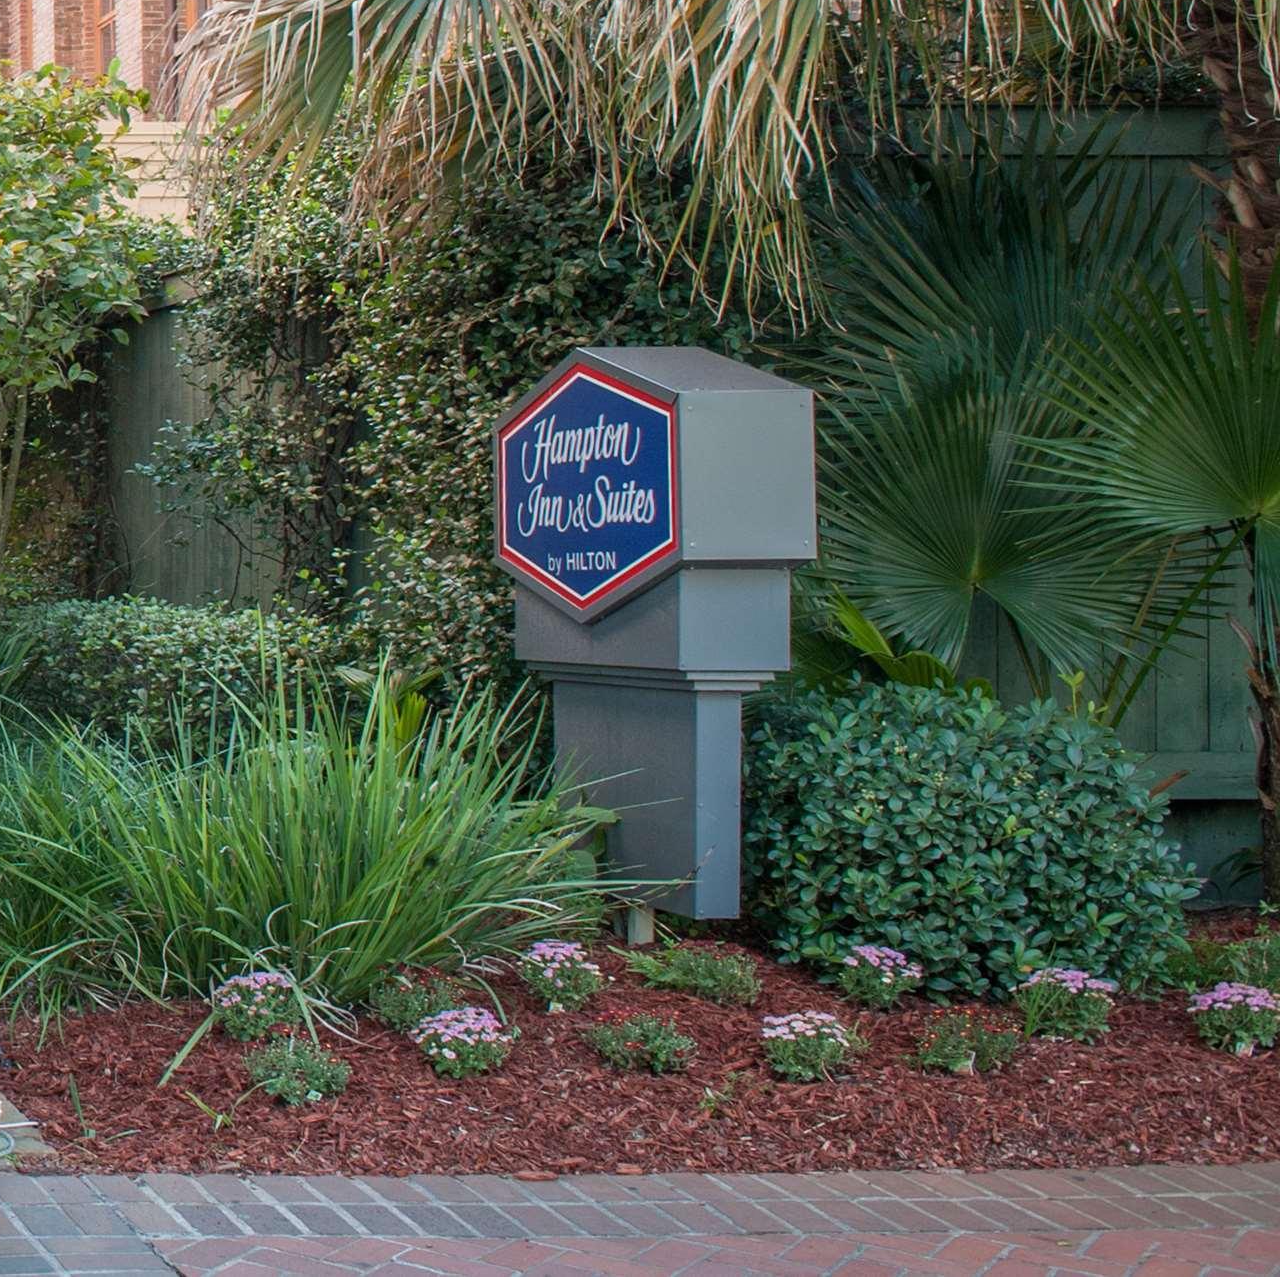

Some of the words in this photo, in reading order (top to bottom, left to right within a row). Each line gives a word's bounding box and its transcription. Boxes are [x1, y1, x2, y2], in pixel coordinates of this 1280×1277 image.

[521, 413, 641, 484] Hampton
[517, 483, 573, 537] Inn
[585, 475, 656, 529] Suites
[547, 553, 562, 576] by
[566, 551, 617, 571] HILTON
